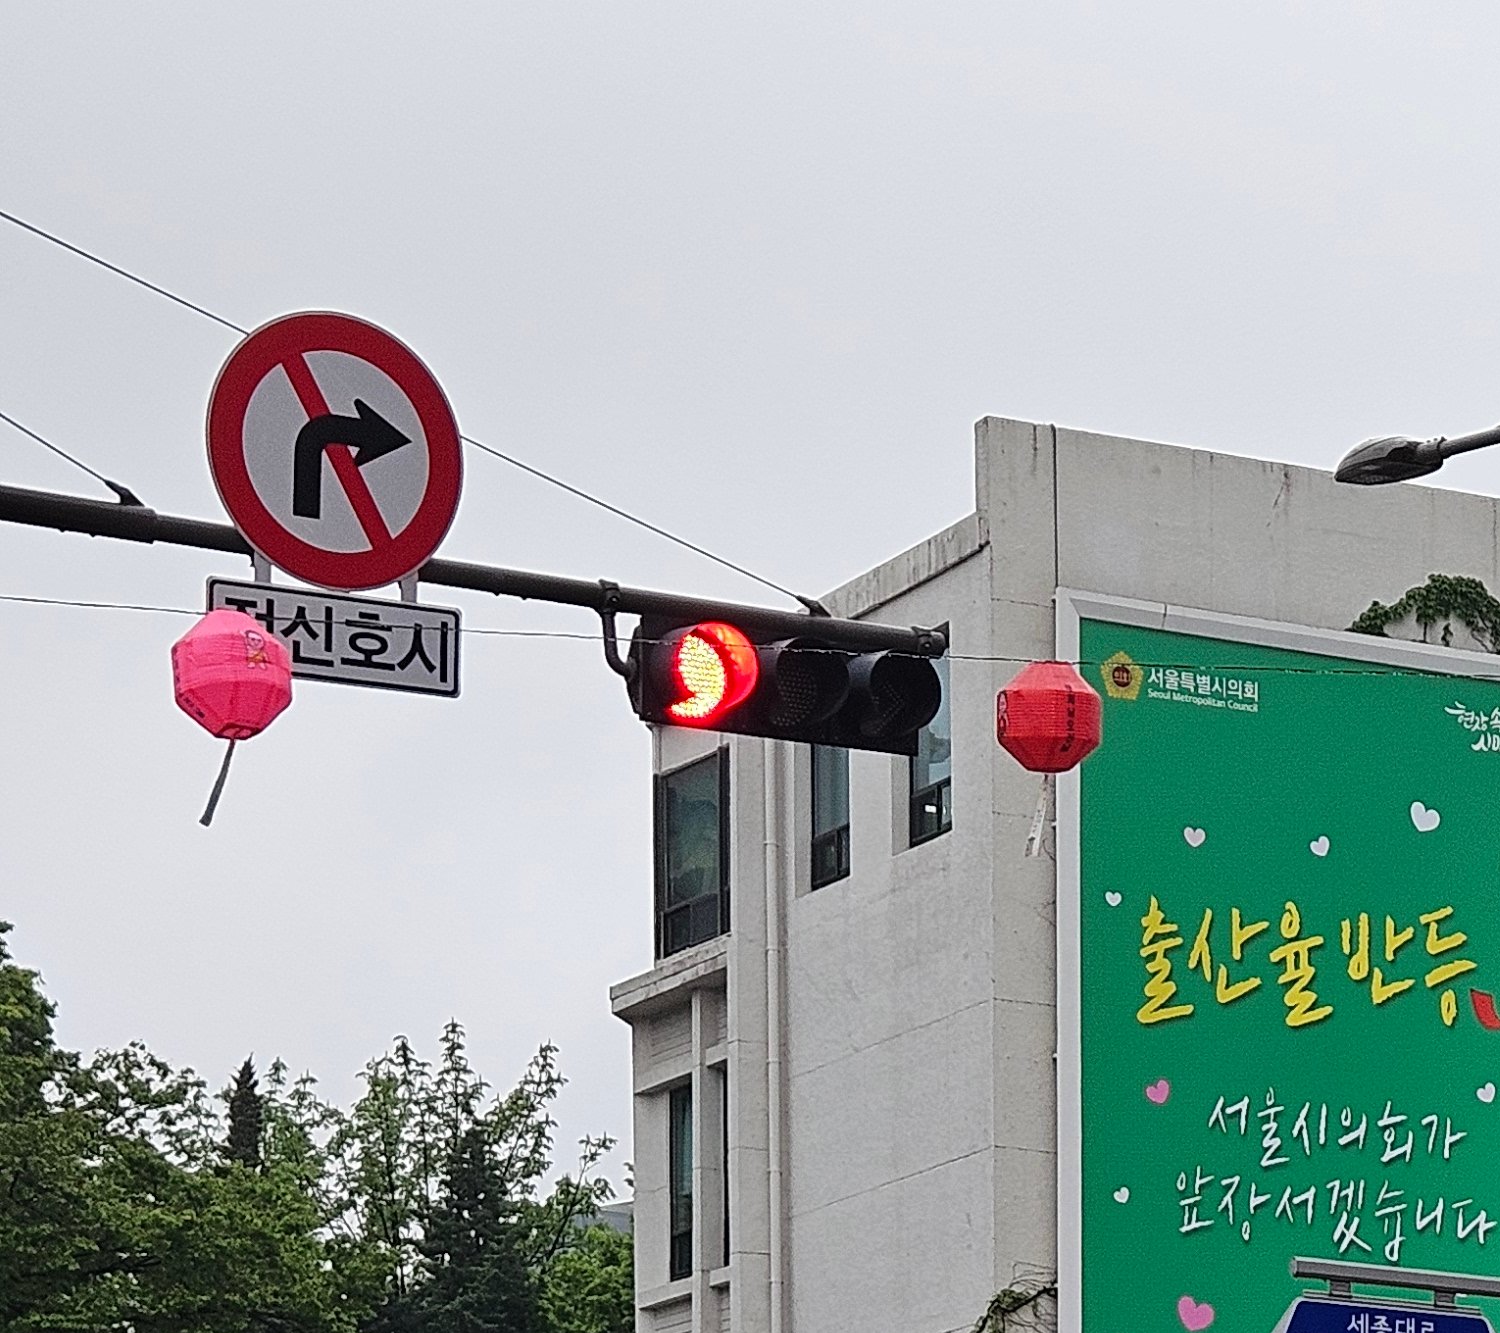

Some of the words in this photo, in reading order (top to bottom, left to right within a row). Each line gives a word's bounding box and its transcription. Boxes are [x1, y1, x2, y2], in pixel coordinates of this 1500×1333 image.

[1147, 667, 1259, 702] 서울특별시의회
[1147, 687, 1171, 700] Seoul
[1172, 691, 1226, 707] Metropolitan
[1227, 699, 1259, 713] Council
[1444, 701, 1489, 732] 현장
[1135, 894, 1334, 1028] 출산율
[1340, 905, 1478, 1027] 반등
[1207, 1086, 1468, 1168] 서울시의회가
[1175, 1165, 1498, 1262] 앞장서겠습니다
